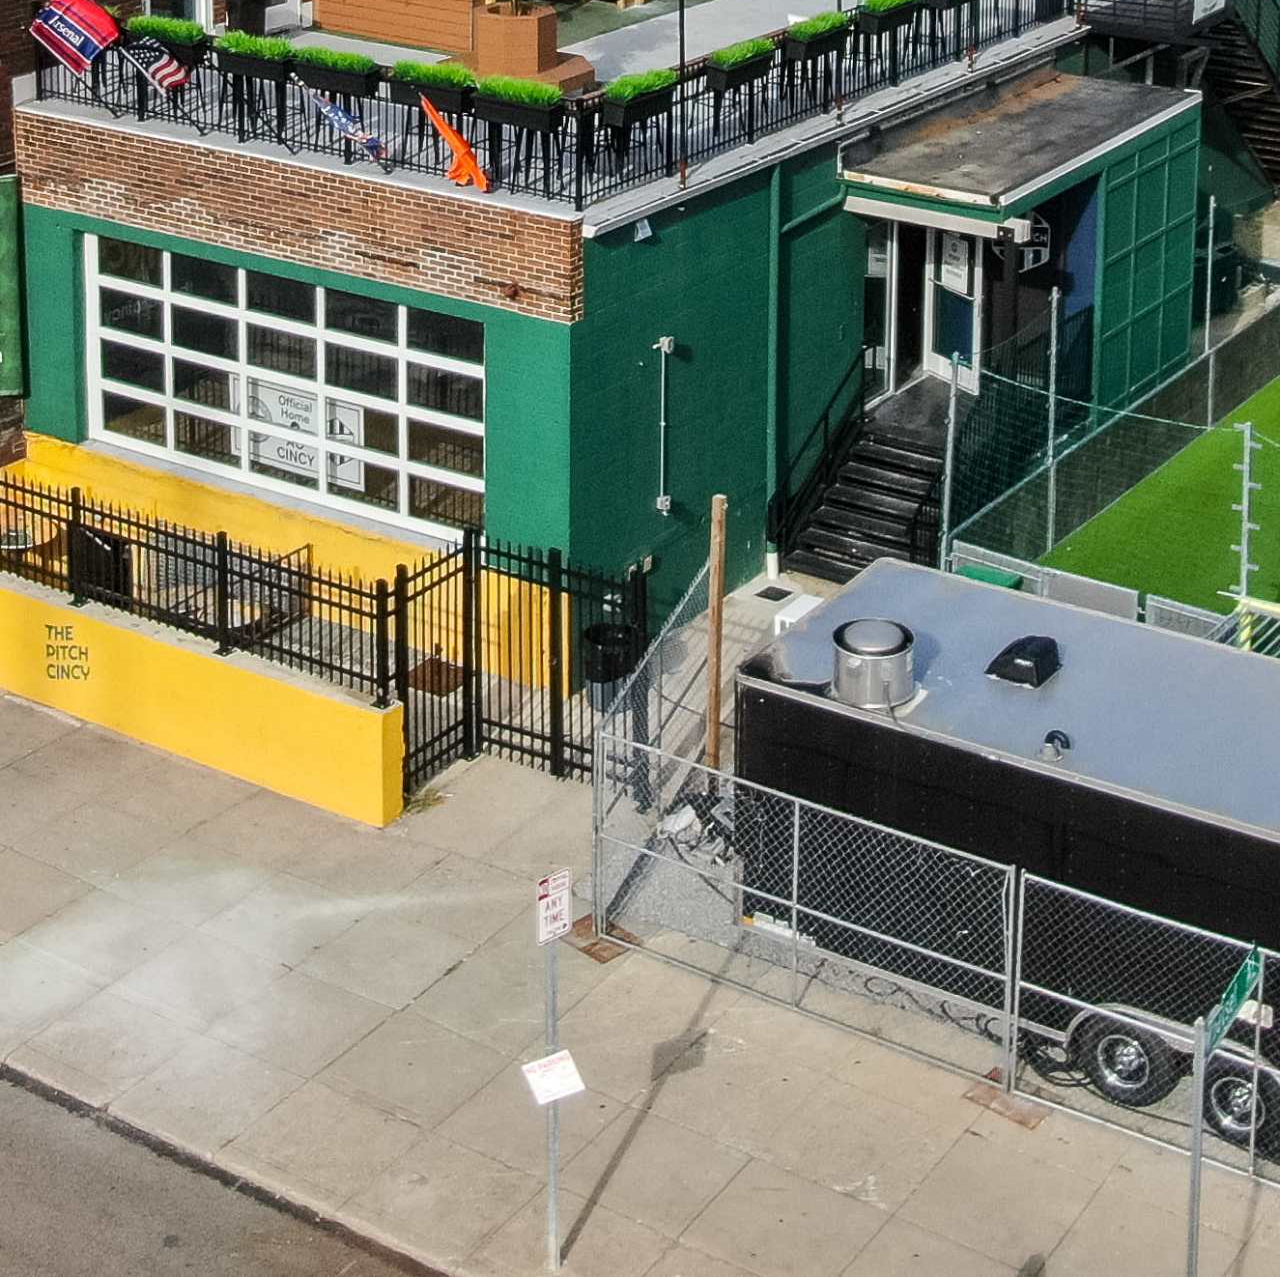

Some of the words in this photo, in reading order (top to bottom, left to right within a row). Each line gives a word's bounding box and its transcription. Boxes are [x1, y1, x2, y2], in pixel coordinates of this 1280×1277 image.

[278, 395, 313, 413] Official
[280, 406, 311, 424] Home
[276, 446, 315, 467] CINCY
[45, 624, 74, 641] THE
[46, 643, 89, 662] PITCH
[46, 663, 90, 681] CINCY
[544, 896, 563, 913] ANY
[544, 908, 565, 930] TIME
